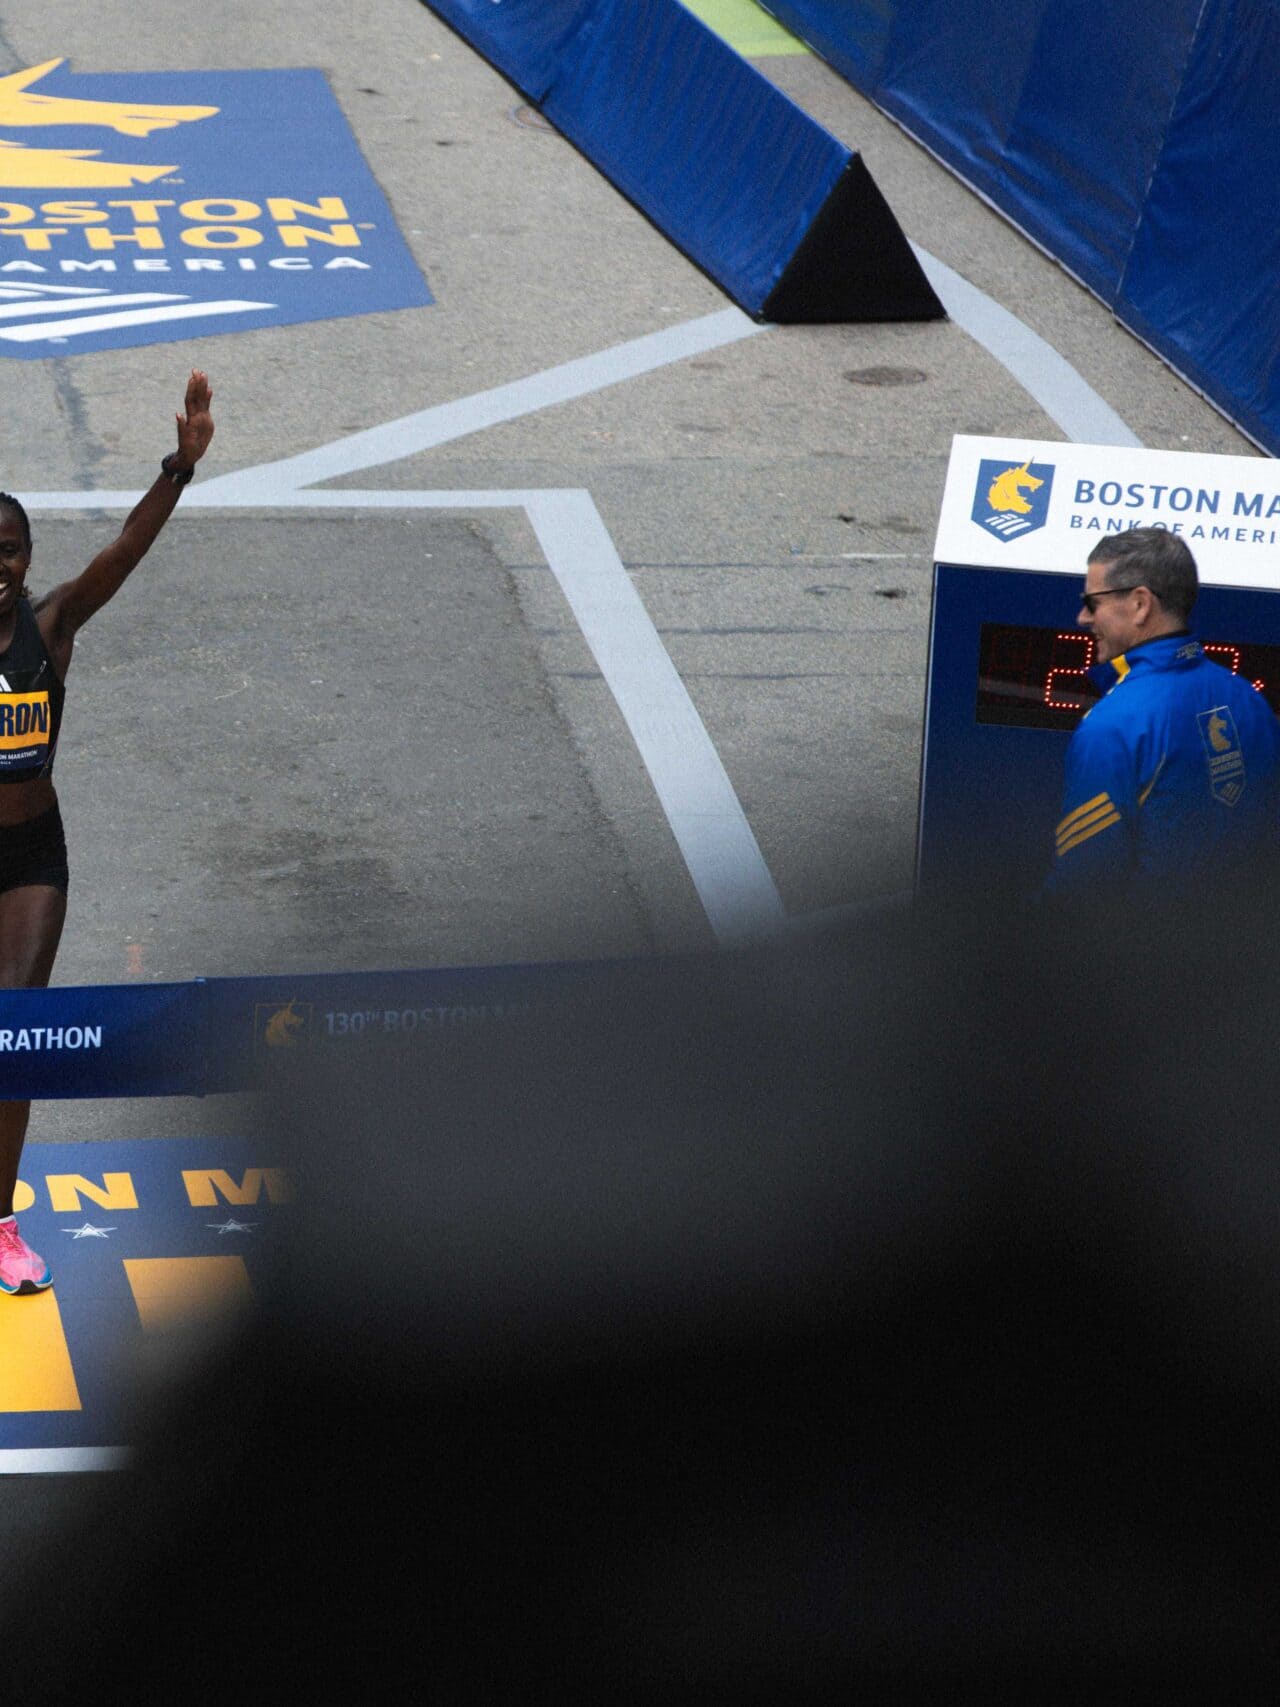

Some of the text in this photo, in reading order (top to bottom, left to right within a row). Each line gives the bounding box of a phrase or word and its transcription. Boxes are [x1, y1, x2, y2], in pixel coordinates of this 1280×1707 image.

[0, 256, 372, 272] AMERICA
[1074, 479, 1221, 514] BOSTON
[8, 750, 38, 760] MARATHON
